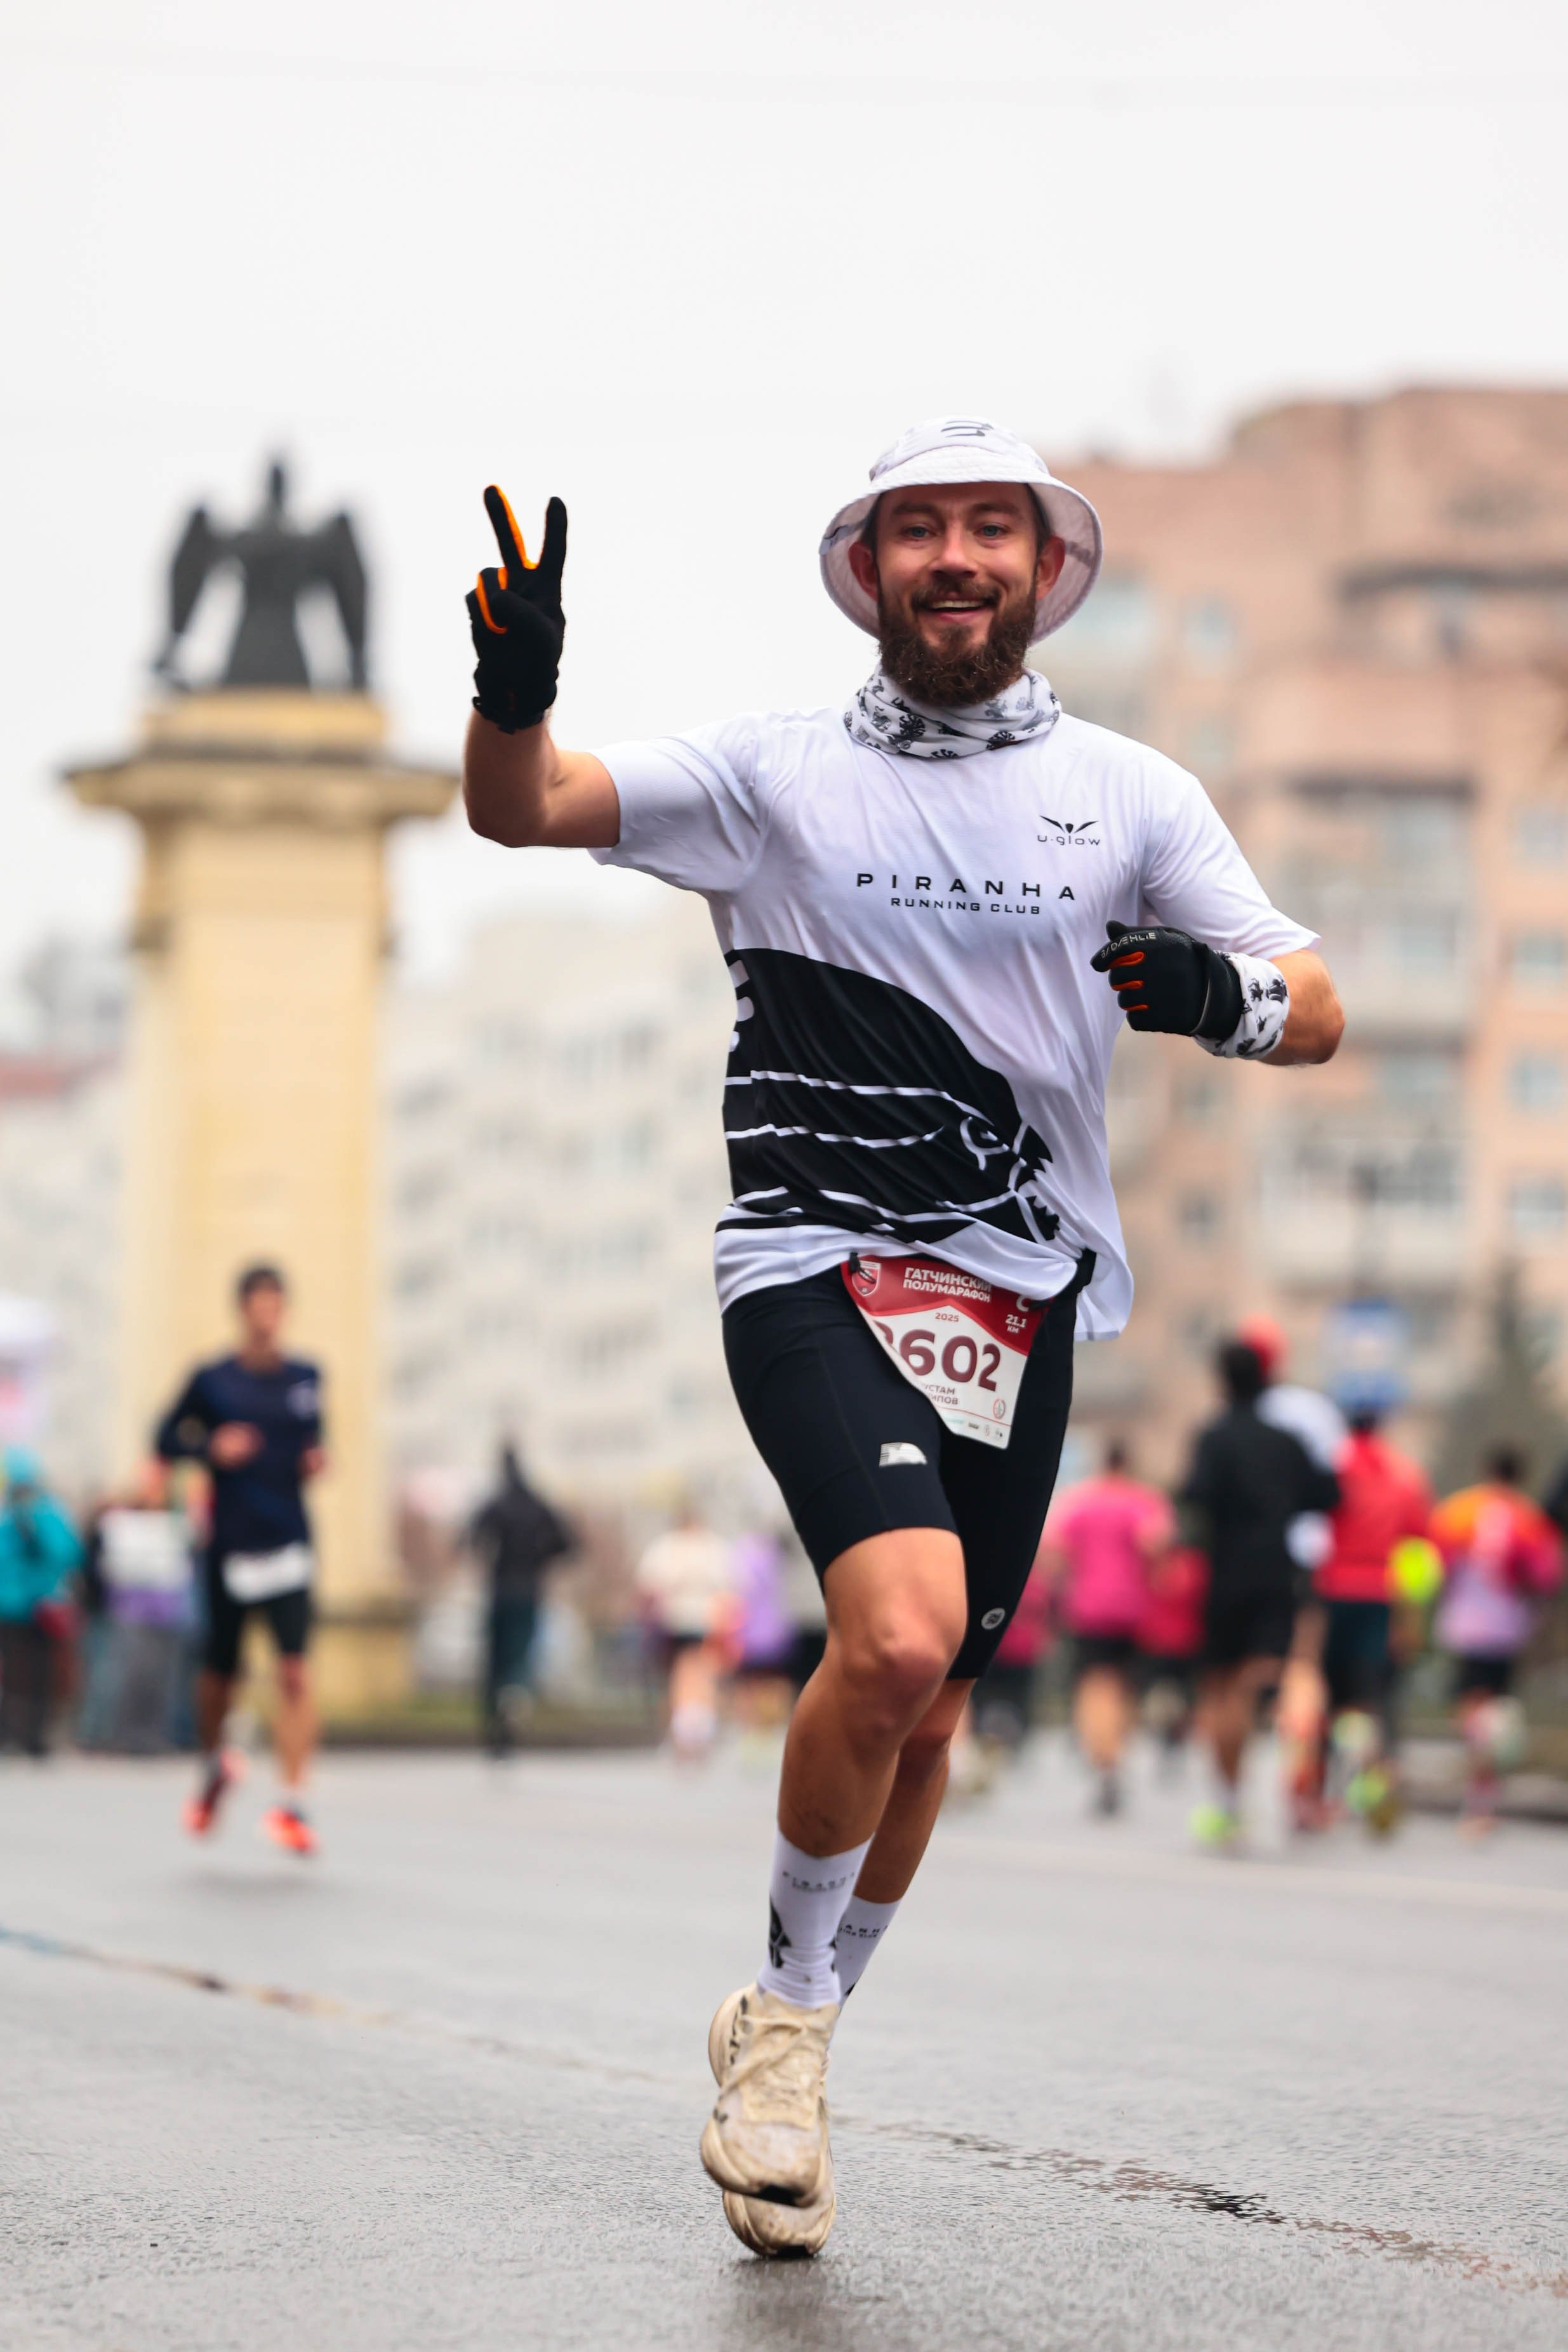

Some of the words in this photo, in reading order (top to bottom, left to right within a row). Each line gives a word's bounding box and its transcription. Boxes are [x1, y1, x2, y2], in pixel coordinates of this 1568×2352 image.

[856, 873, 1075, 900] PIRANHA
[891, 897, 981, 912] RUNNING
[990, 903, 1040, 915] CLUB
[903, 1279, 991, 1303] ПОЛУМАРАФОН
[935, 1312, 959, 1322] 2025
